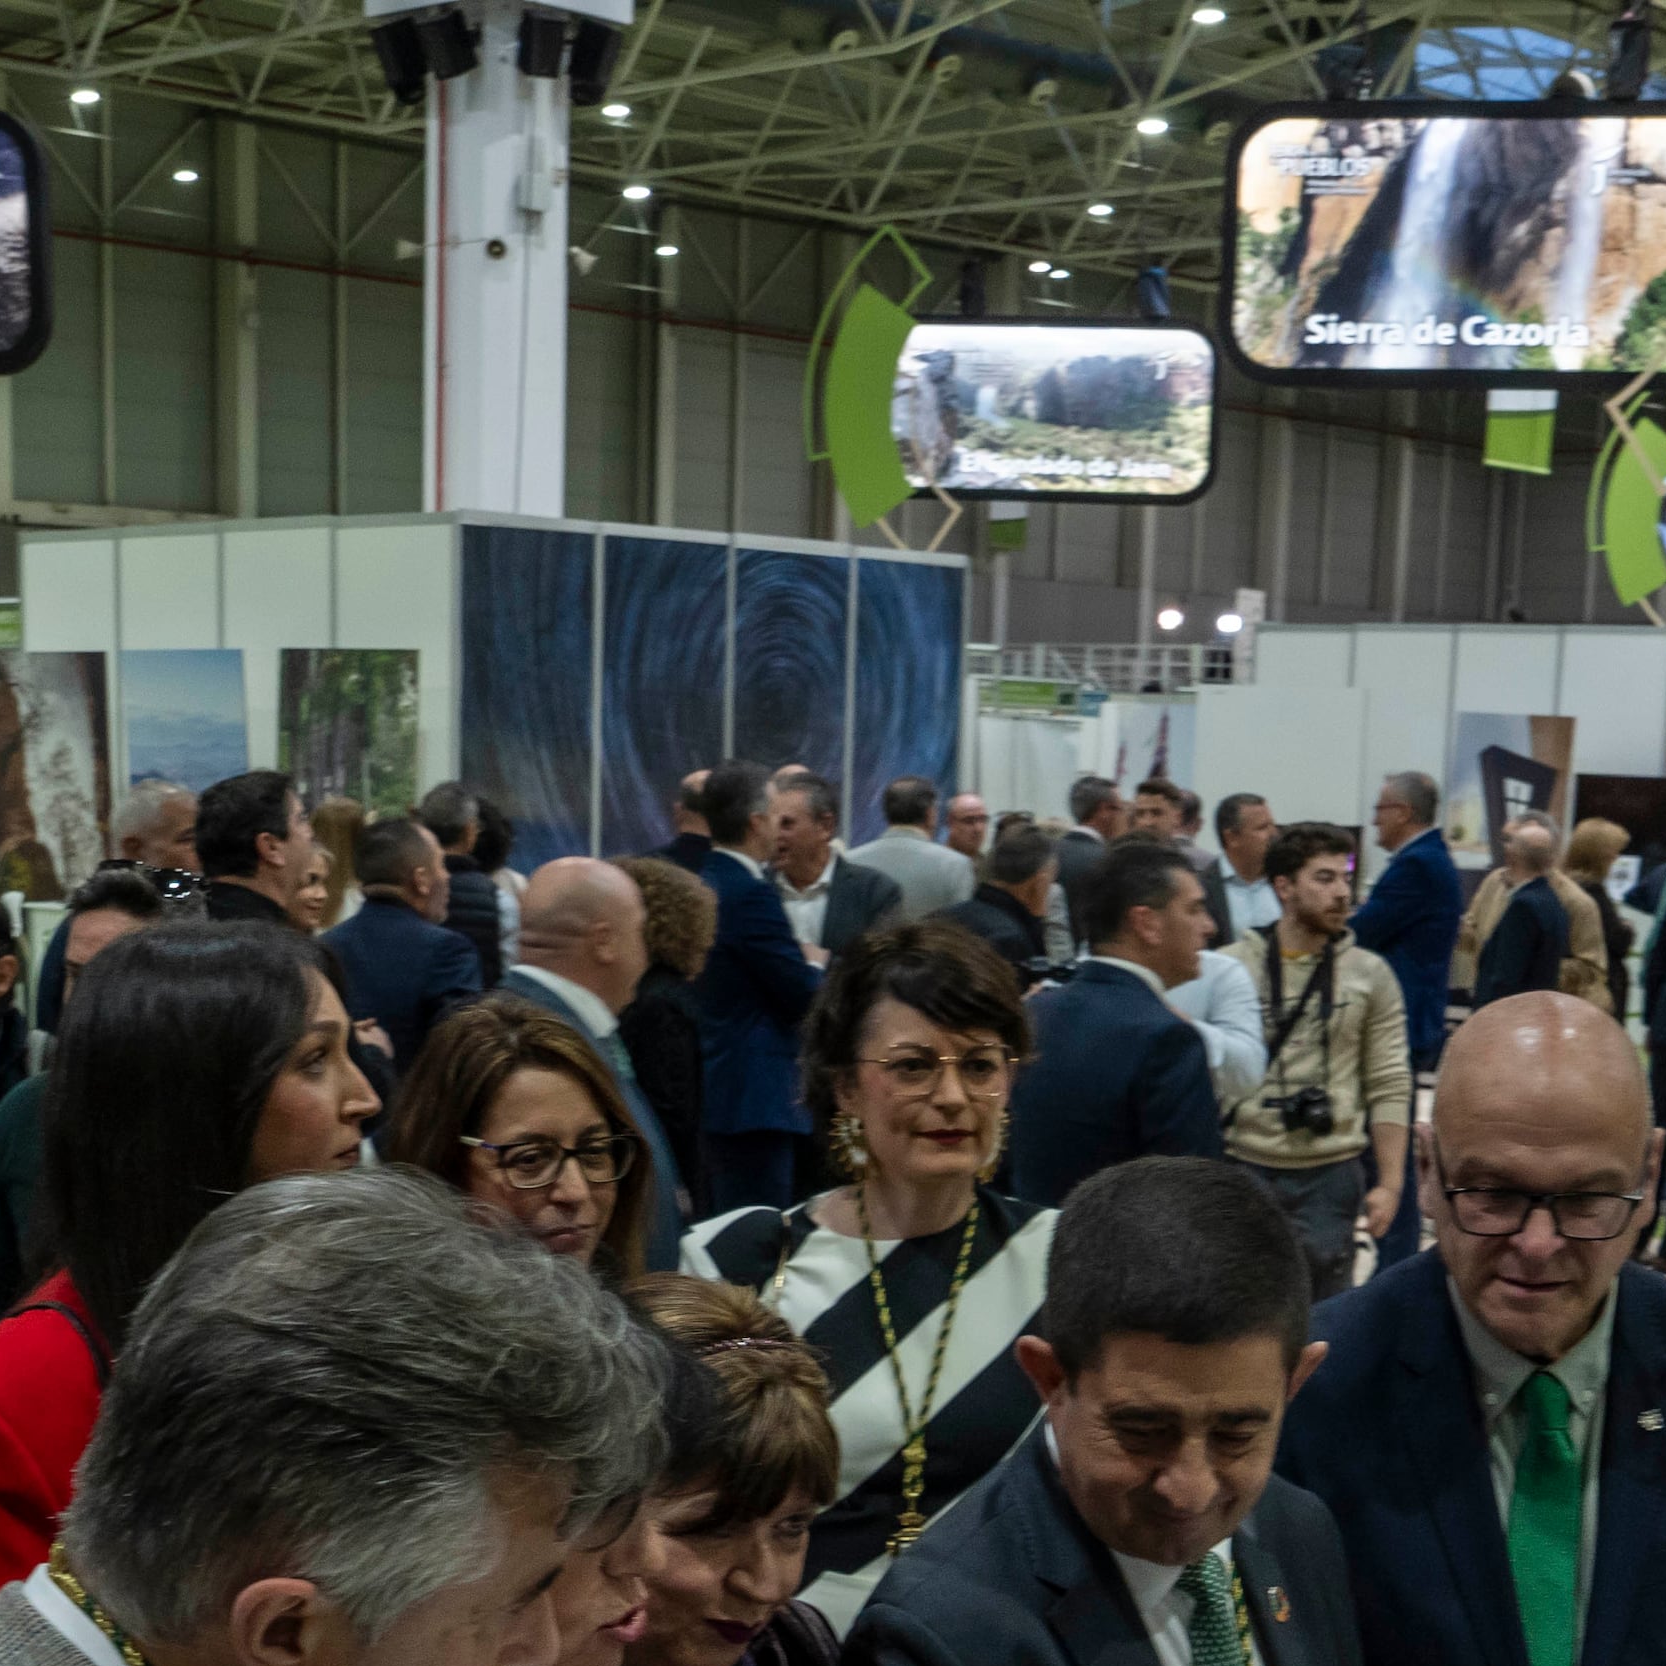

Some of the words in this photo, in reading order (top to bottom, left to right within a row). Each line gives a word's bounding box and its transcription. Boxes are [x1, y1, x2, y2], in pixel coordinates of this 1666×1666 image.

[1304, 314, 1400, 345] Sierra
[1416, 315, 1455, 344] de
[1461, 316, 1590, 347] Cazorla
